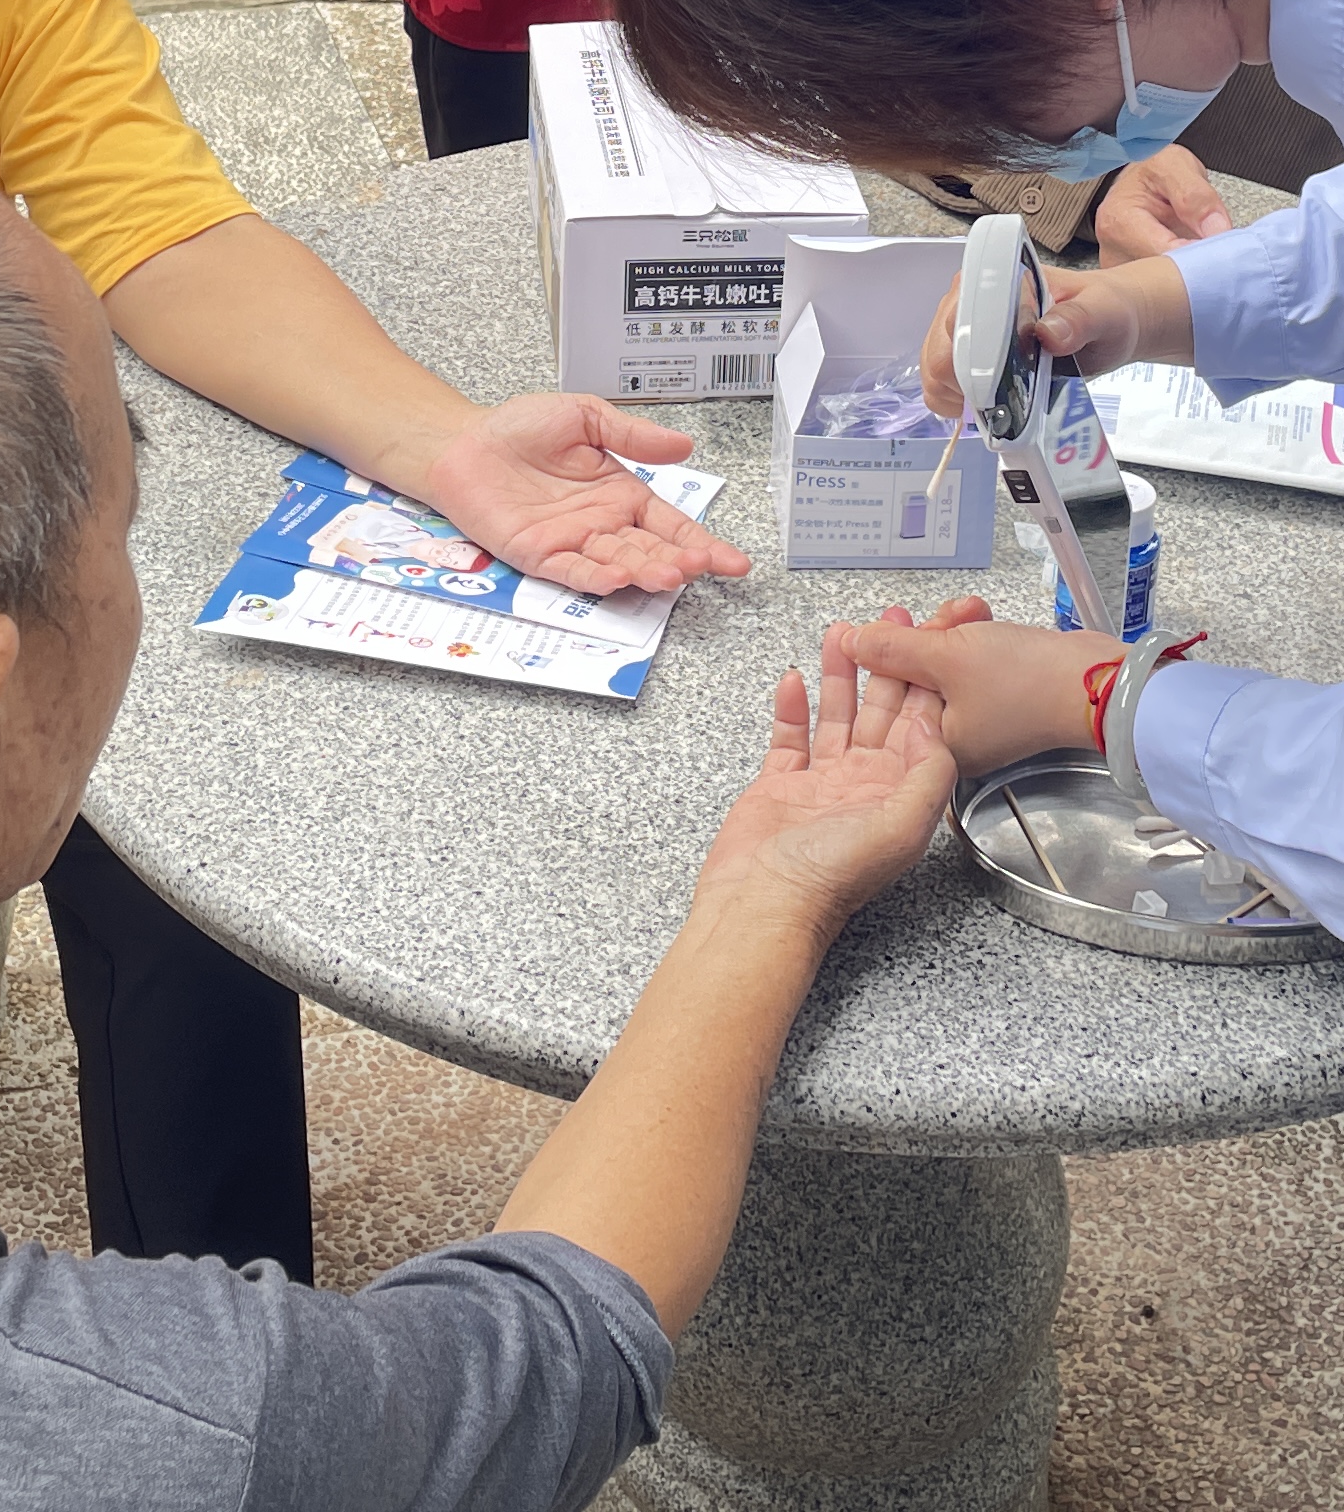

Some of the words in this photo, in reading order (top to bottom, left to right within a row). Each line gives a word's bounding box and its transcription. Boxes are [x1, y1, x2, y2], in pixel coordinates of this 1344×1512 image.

[682, 229, 748, 242] 三只松鼠
[634, 266, 664, 275] HIGH
[668, 265, 720, 274] CALCIUM
[724, 264, 753, 273] MILK
[642, 336, 690, 344] TEMPERATURE
[795, 471, 846, 489] Press
